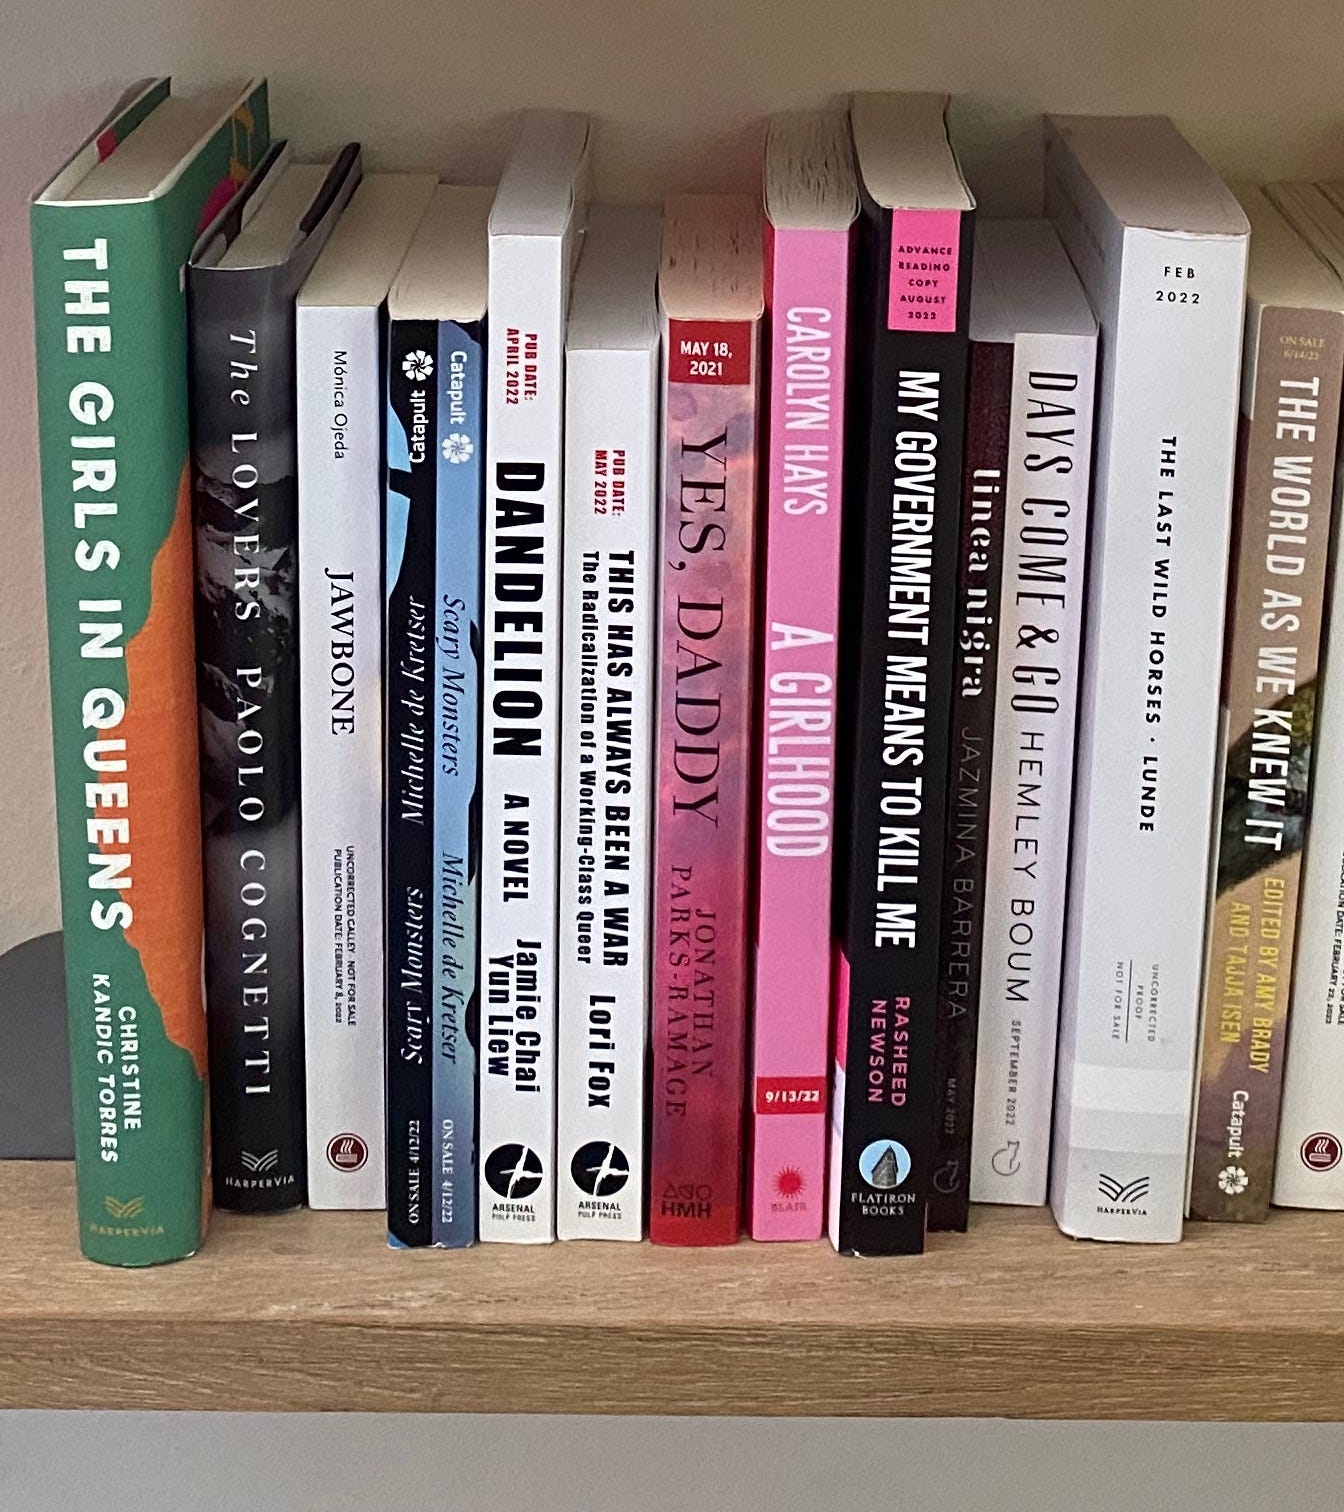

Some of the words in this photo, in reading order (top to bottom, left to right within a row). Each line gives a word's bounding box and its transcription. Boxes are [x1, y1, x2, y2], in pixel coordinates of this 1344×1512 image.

[63, 238, 112, 353] THE
[1156, 291, 1200, 304] 2022
[1164, 266, 1195, 279] FEB
[229, 329, 257, 407] The
[334, 350, 347, 407] Mónica
[507, 328, 519, 366] APRIL
[680, 340, 709, 356] MAY
[713, 342, 732, 358] 18,
[690, 360, 723, 376] 2021
[784, 306, 832, 430] CAROLYN
[447, 350, 468, 424] Catapult
[507, 372, 518, 404] 2022
[897, 370, 940, 421] MY
[1023, 371, 1078, 474] DAYS
[1276, 377, 1320, 442] THE
[330, 413, 348, 459] Ojeda
[1159, 436, 1177, 478] THE
[68, 380, 121, 572] GIRLS
[668, 426, 728, 571] YES,
[784, 444, 829, 516] HAYS
[231, 432, 261, 620] LOVERS
[887, 430, 938, 646] GOVERNMENT
[1155, 491, 1175, 546] LAST
[1265, 455, 1314, 577] WORLD
[582, 551, 599, 583] The
[608, 550, 634, 613] THIS
[1016, 497, 1071, 609] COME
[1152, 558, 1169, 618] WILD
[79, 599, 123, 659] IN
[436, 594, 466, 658] Scary
[492, 462, 545, 756] DANDELION
[770, 622, 833, 651] A
[1016, 625, 1059, 649] &
[1260, 589, 1302, 632] AS
[324, 567, 355, 736] JAWBONE
[580, 590, 598, 724] Radicalization
[607, 625, 633, 677] HAS
[1145, 631, 1165, 724] HORSES
[1256, 647, 1298, 695] WE
[442, 669, 464, 776] Monsters
[673, 595, 723, 828] DADDY
[882, 655, 928, 766] MEANS
[1010, 665, 1061, 713] GO
[236, 667, 265, 821] PAOLO
[580, 754, 594, 763] a
[581, 730, 596, 748] of
[605, 687, 632, 794] ALWAYS
[766, 671, 833, 857] GIRLHOOD
[1247, 708, 1293, 807] KNEW
[81, 687, 134, 930] QUEENS
[879, 777, 922, 817] TO
[1012, 731, 1044, 879] HEMLEY
[1139, 756, 1158, 832] LUNDE
[503, 820, 529, 902] NOVEL
[577, 770, 596, 908] Working-Class
[604, 806, 630, 870] BEEN
[876, 827, 920, 892] KILL
[1244, 819, 1284, 851] IT
[346, 846, 354, 917] UNCORRECTED
[442, 851, 465, 946] Michelle
[604, 878, 629, 896] A
[577, 912, 595, 964] Queer
[604, 908, 629, 967] WAR
[874, 902, 918, 949] ME
[1005, 899, 1034, 1002] BOUM
[239, 849, 271, 1095] COGNETTI
[441, 956, 464, 978] de
[488, 954, 514, 1003] Yun
[516, 939, 541, 1020] Jamie
[665, 864, 692, 1118] PARKS-RAMAGE
[691, 907, 716, 1077] JONATHAN
[93, 973, 114, 1065] KANDIC
[348, 1004, 356, 1026] SALE
[441, 986, 462, 1065] Kretser
[488, 1015, 513, 1076] Liew
[589, 995, 615, 1049] Lori
[118, 1006, 142, 1130] CHRISTINE
[515, 1030, 540, 1092] Chai
[588, 1061, 615, 1108] Fox
[868, 999, 887, 1103] NEWSON
[891, 996, 911, 1107] RASHEED
[98, 1074, 118, 1163] TORRES
